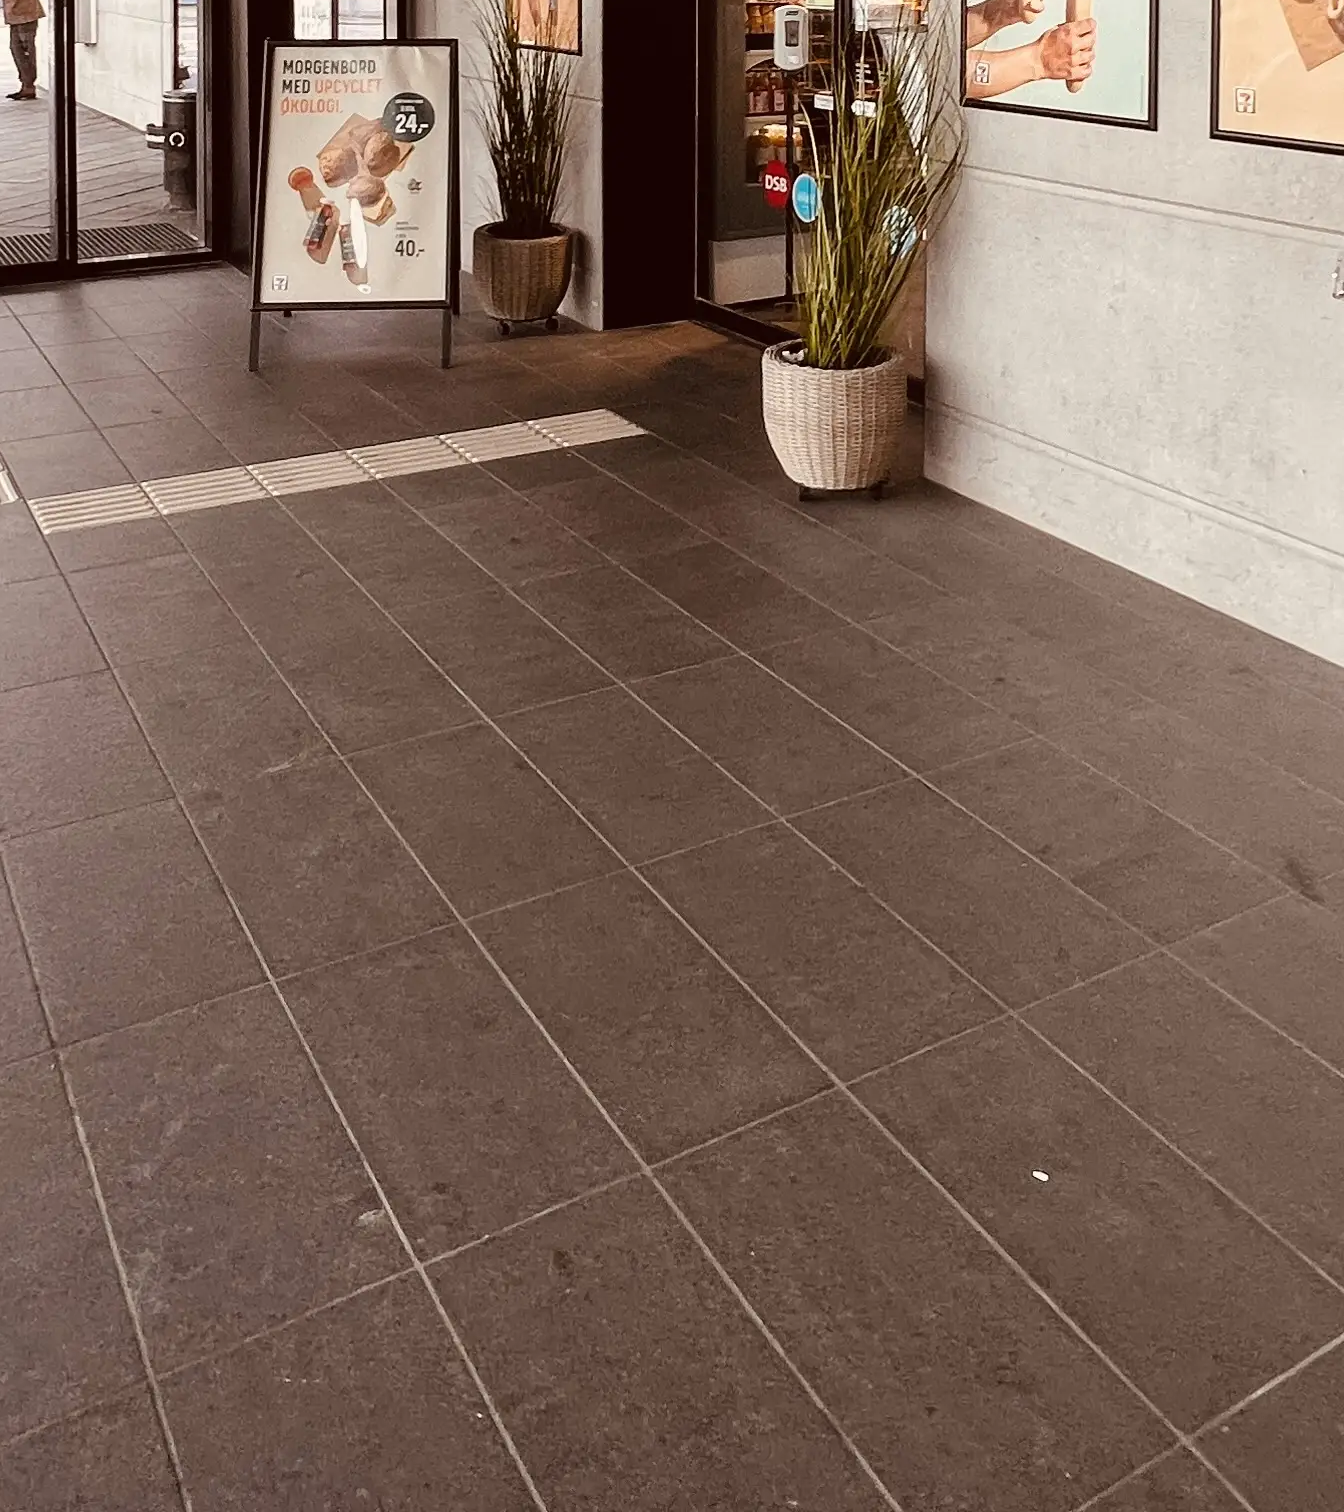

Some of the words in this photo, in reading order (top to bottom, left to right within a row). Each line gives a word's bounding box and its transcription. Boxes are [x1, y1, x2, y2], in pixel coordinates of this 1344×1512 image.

[282, 59, 377, 75] MORGENBORD
[281, 79, 311, 94] MED
[314, 78, 384, 94] UPCYCLET
[764, 173, 788, 193] DSB
